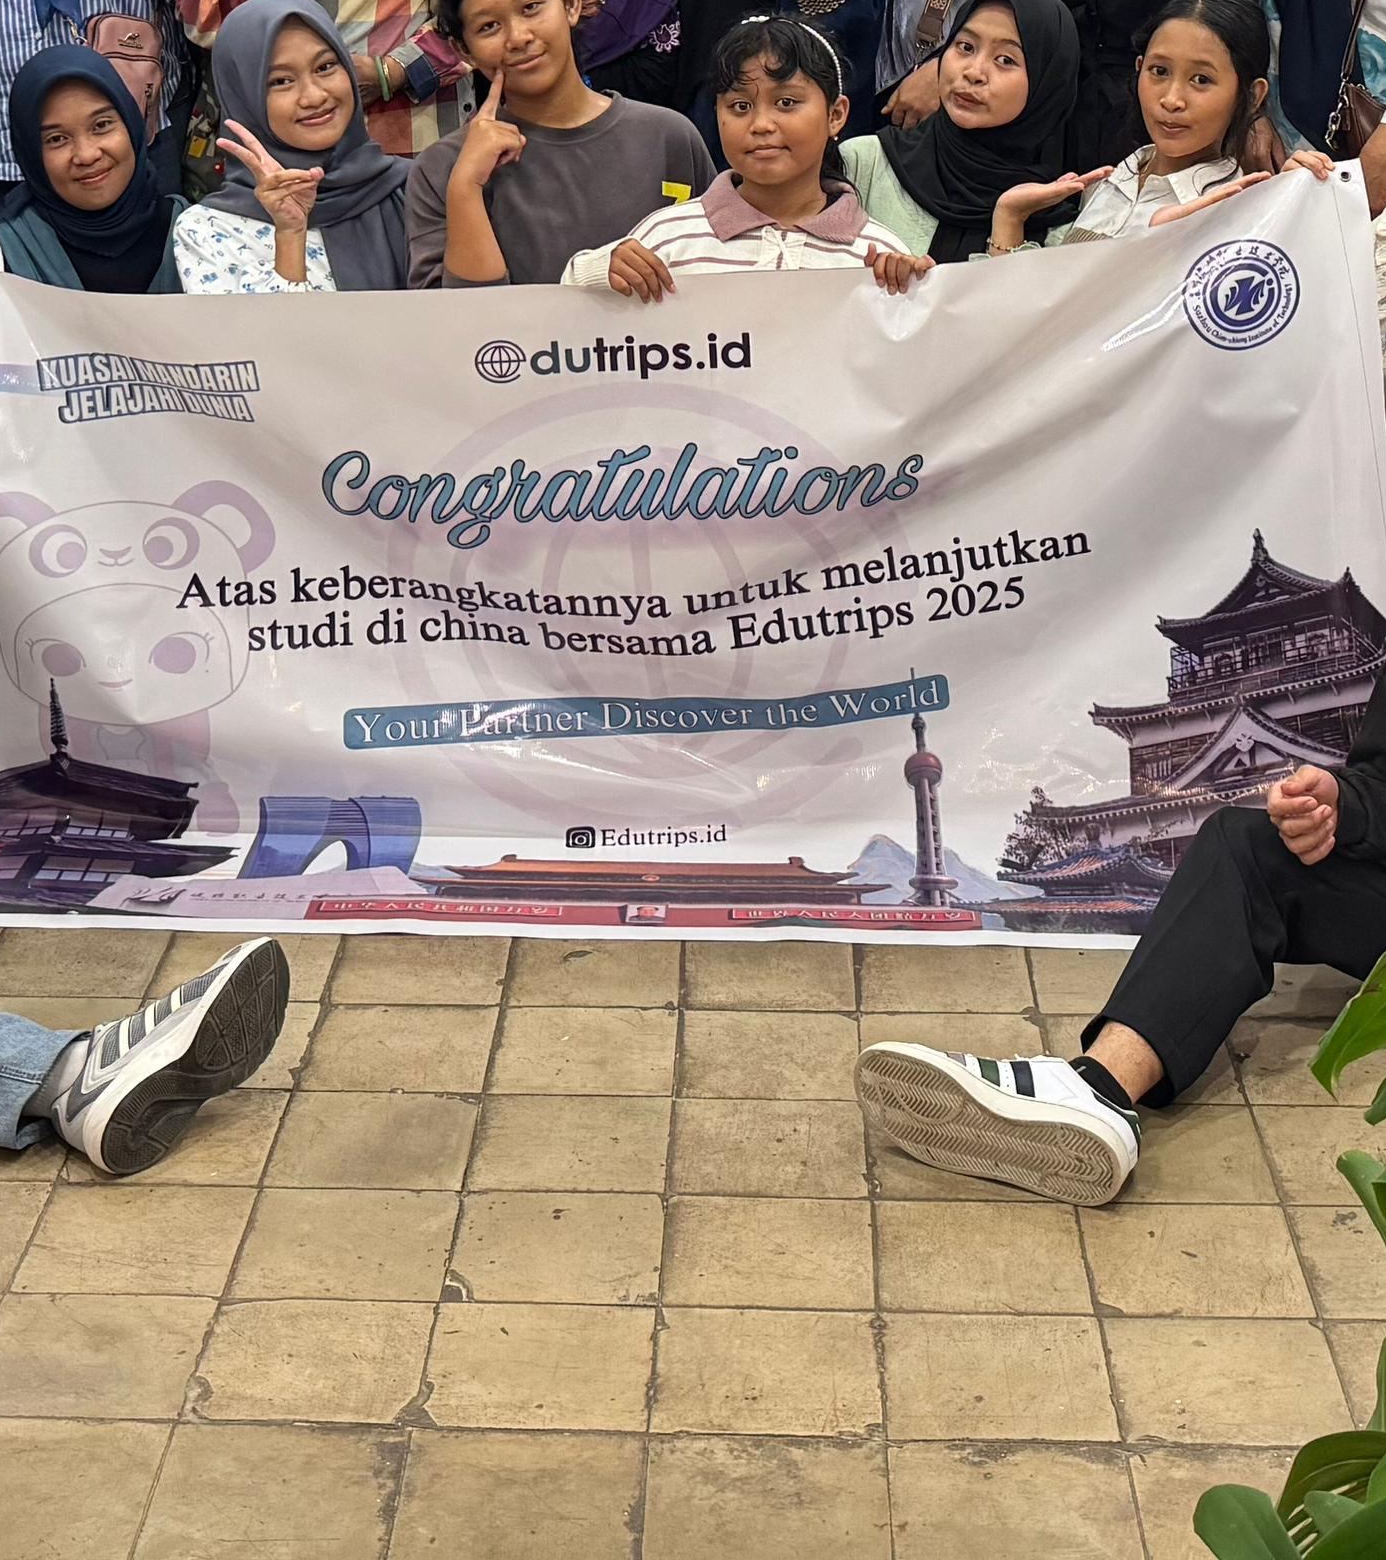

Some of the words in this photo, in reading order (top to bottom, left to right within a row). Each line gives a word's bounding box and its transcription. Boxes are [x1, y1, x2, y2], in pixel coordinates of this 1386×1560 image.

[37, 353, 137, 390] KUASAI
[130, 357, 260, 392] MANDARIN
[59, 384, 186, 423] JELAJAHI
[178, 388, 255, 422] DUNIA
[321, 443, 924, 550] Congratulations
[176, 572, 277, 608] Atas
[290, 565, 671, 625] keberangkatannya
[684, 568, 809, 615] untuk
[821, 529, 1092, 592] melanjutkan
[248, 610, 354, 652] studi
[366, 608, 407, 645] di
[419, 610, 530, 646] china
[538, 622, 716, 657] bersama
[727, 597, 914, 650] Edutrips
[927, 576, 1025, 622] 2025
[354, 714, 443, 742] Your
[460, 707, 588, 737] Partner
[601, 702, 753, 730] Discover
[766, 703, 818, 726] the
[829, 680, 940, 718] World
[601, 824, 727, 848] Edutrips.id
